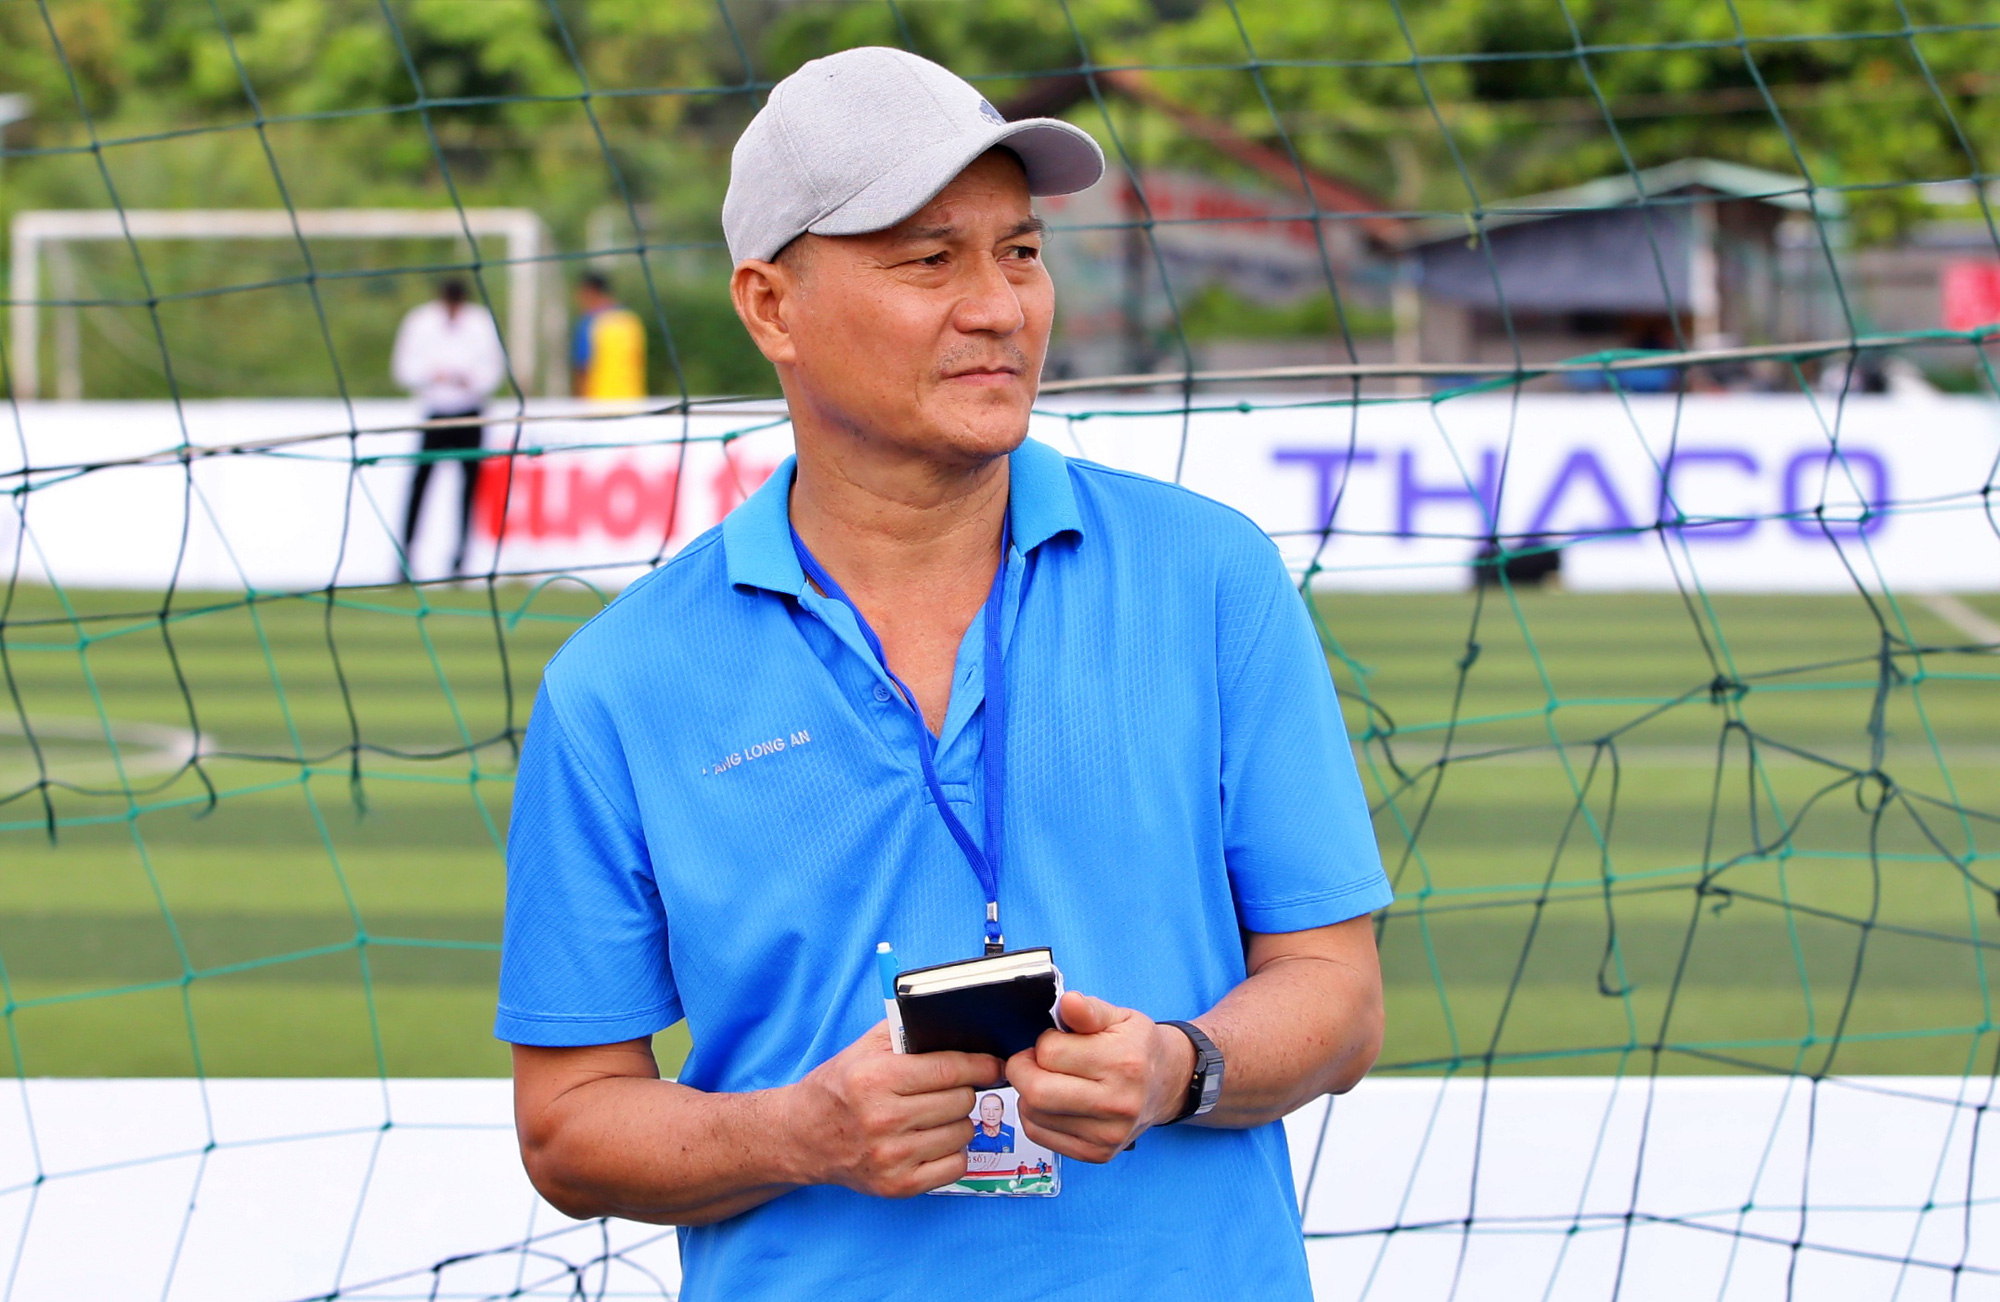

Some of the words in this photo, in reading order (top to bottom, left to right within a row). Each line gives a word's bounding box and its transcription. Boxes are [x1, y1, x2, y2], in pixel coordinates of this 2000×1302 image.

[1271, 446, 1890, 543] THACO
[744, 737, 786, 761] LONG
[789, 729, 811, 748] AN
